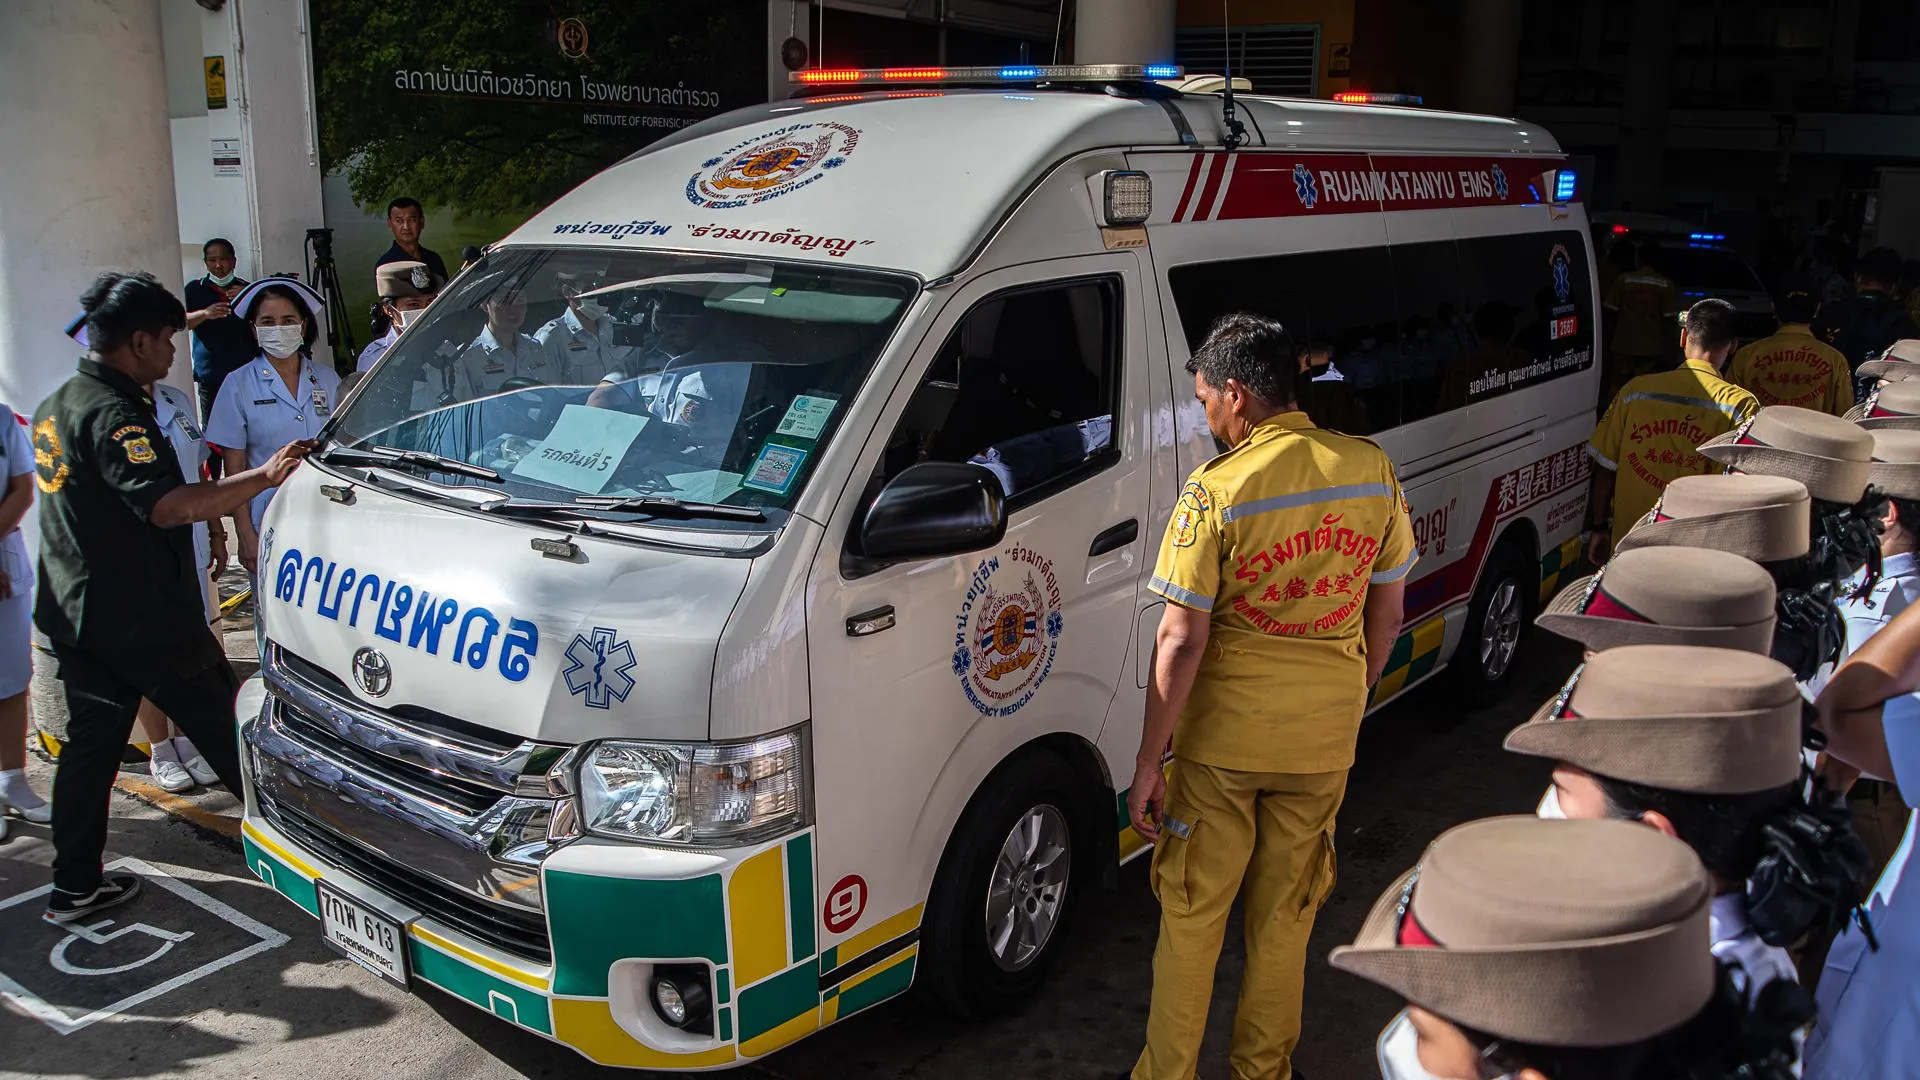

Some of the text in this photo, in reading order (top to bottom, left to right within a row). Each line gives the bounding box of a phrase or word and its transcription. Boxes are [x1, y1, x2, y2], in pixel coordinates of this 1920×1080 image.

[394, 64, 720, 108] สถาบันนิติเวชวิทยา โรงพยาบาลตำรวจ
[583, 113, 628, 126] INSTITUTE
[628, 115, 640, 126] OF
[642, 116, 681, 128] FORENSIC
[702, 199, 749, 210] MEDICAL
[751, 172, 824, 205] SERVICES
[735, 181, 796, 200] FOUNDATION
[1319, 170, 1493, 202] RUAMKATANYU EMS
[553, 220, 673, 240] หน่วยกู้ชีพ
[1754, 345, 1833, 379] ร่วมกตัญญู
[111, 425, 147, 441] RESCUE
[541, 447, 612, 472] รถคันที่ 5
[1235, 512, 1380, 584] ร่วมกตัญญู
[955, 556, 1000, 647] หน่วยกู้ชีพ
[1260, 573, 1354, 603] 義德善堂
[1232, 593, 1310, 636] RUAMKATANYU
[961, 641, 1058, 718] EMERGENCY MEDICAL SERVICE
[972, 645, 1048, 700] RUAMKATANYU FOUNDATION
[335, 930, 394, 971] กรุงเทพมหานคร
[364, 914, 395, 953] 613
